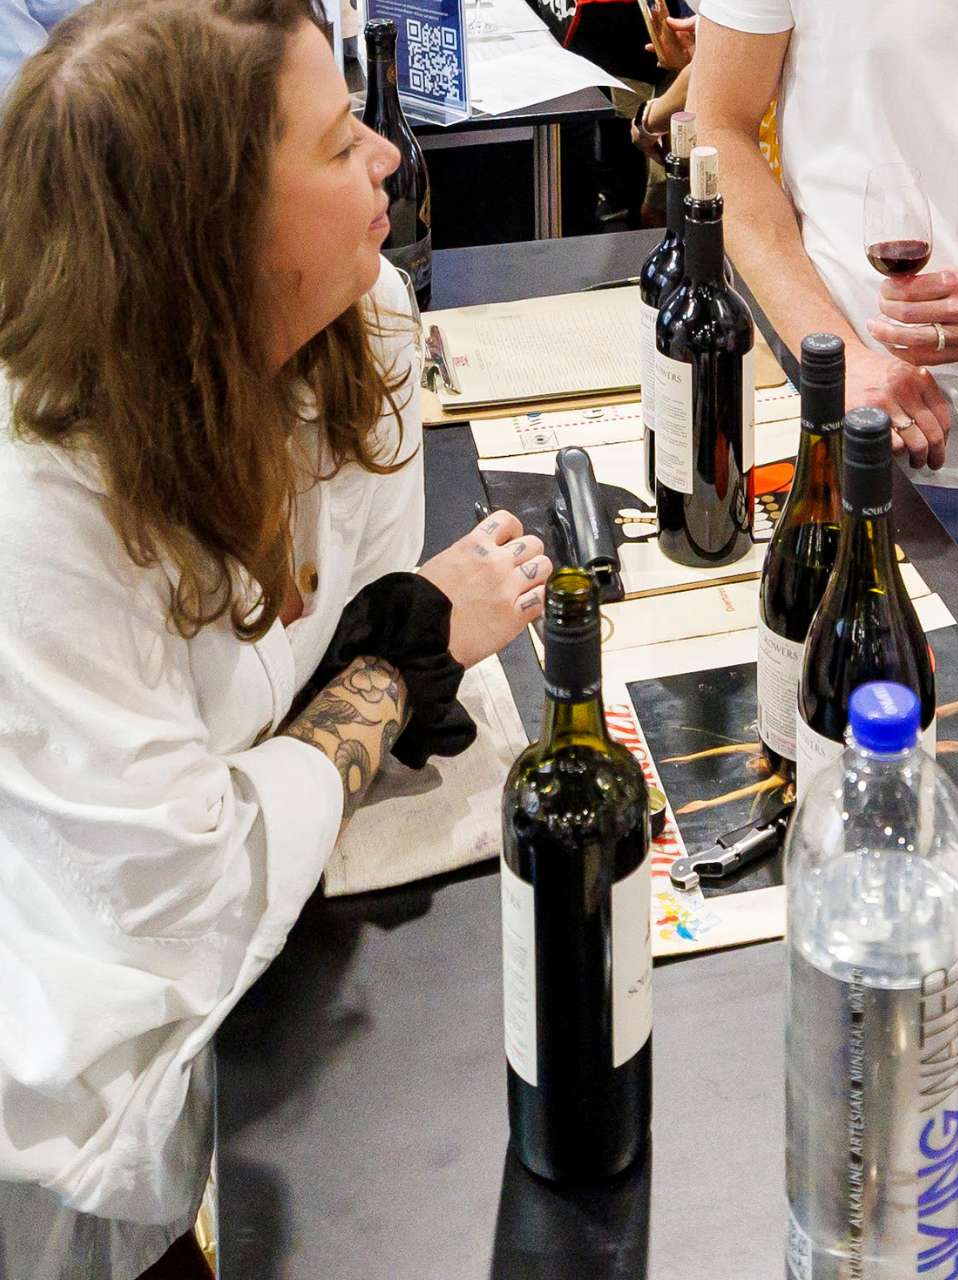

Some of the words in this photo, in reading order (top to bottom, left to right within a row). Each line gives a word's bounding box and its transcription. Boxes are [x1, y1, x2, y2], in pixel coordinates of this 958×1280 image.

[848, 968, 865, 1014] WATER
[848, 1021, 865, 1082] MINERAL
[848, 1088, 865, 1157] ARTESIAN
[848, 1158, 865, 1226] ALKALINE
